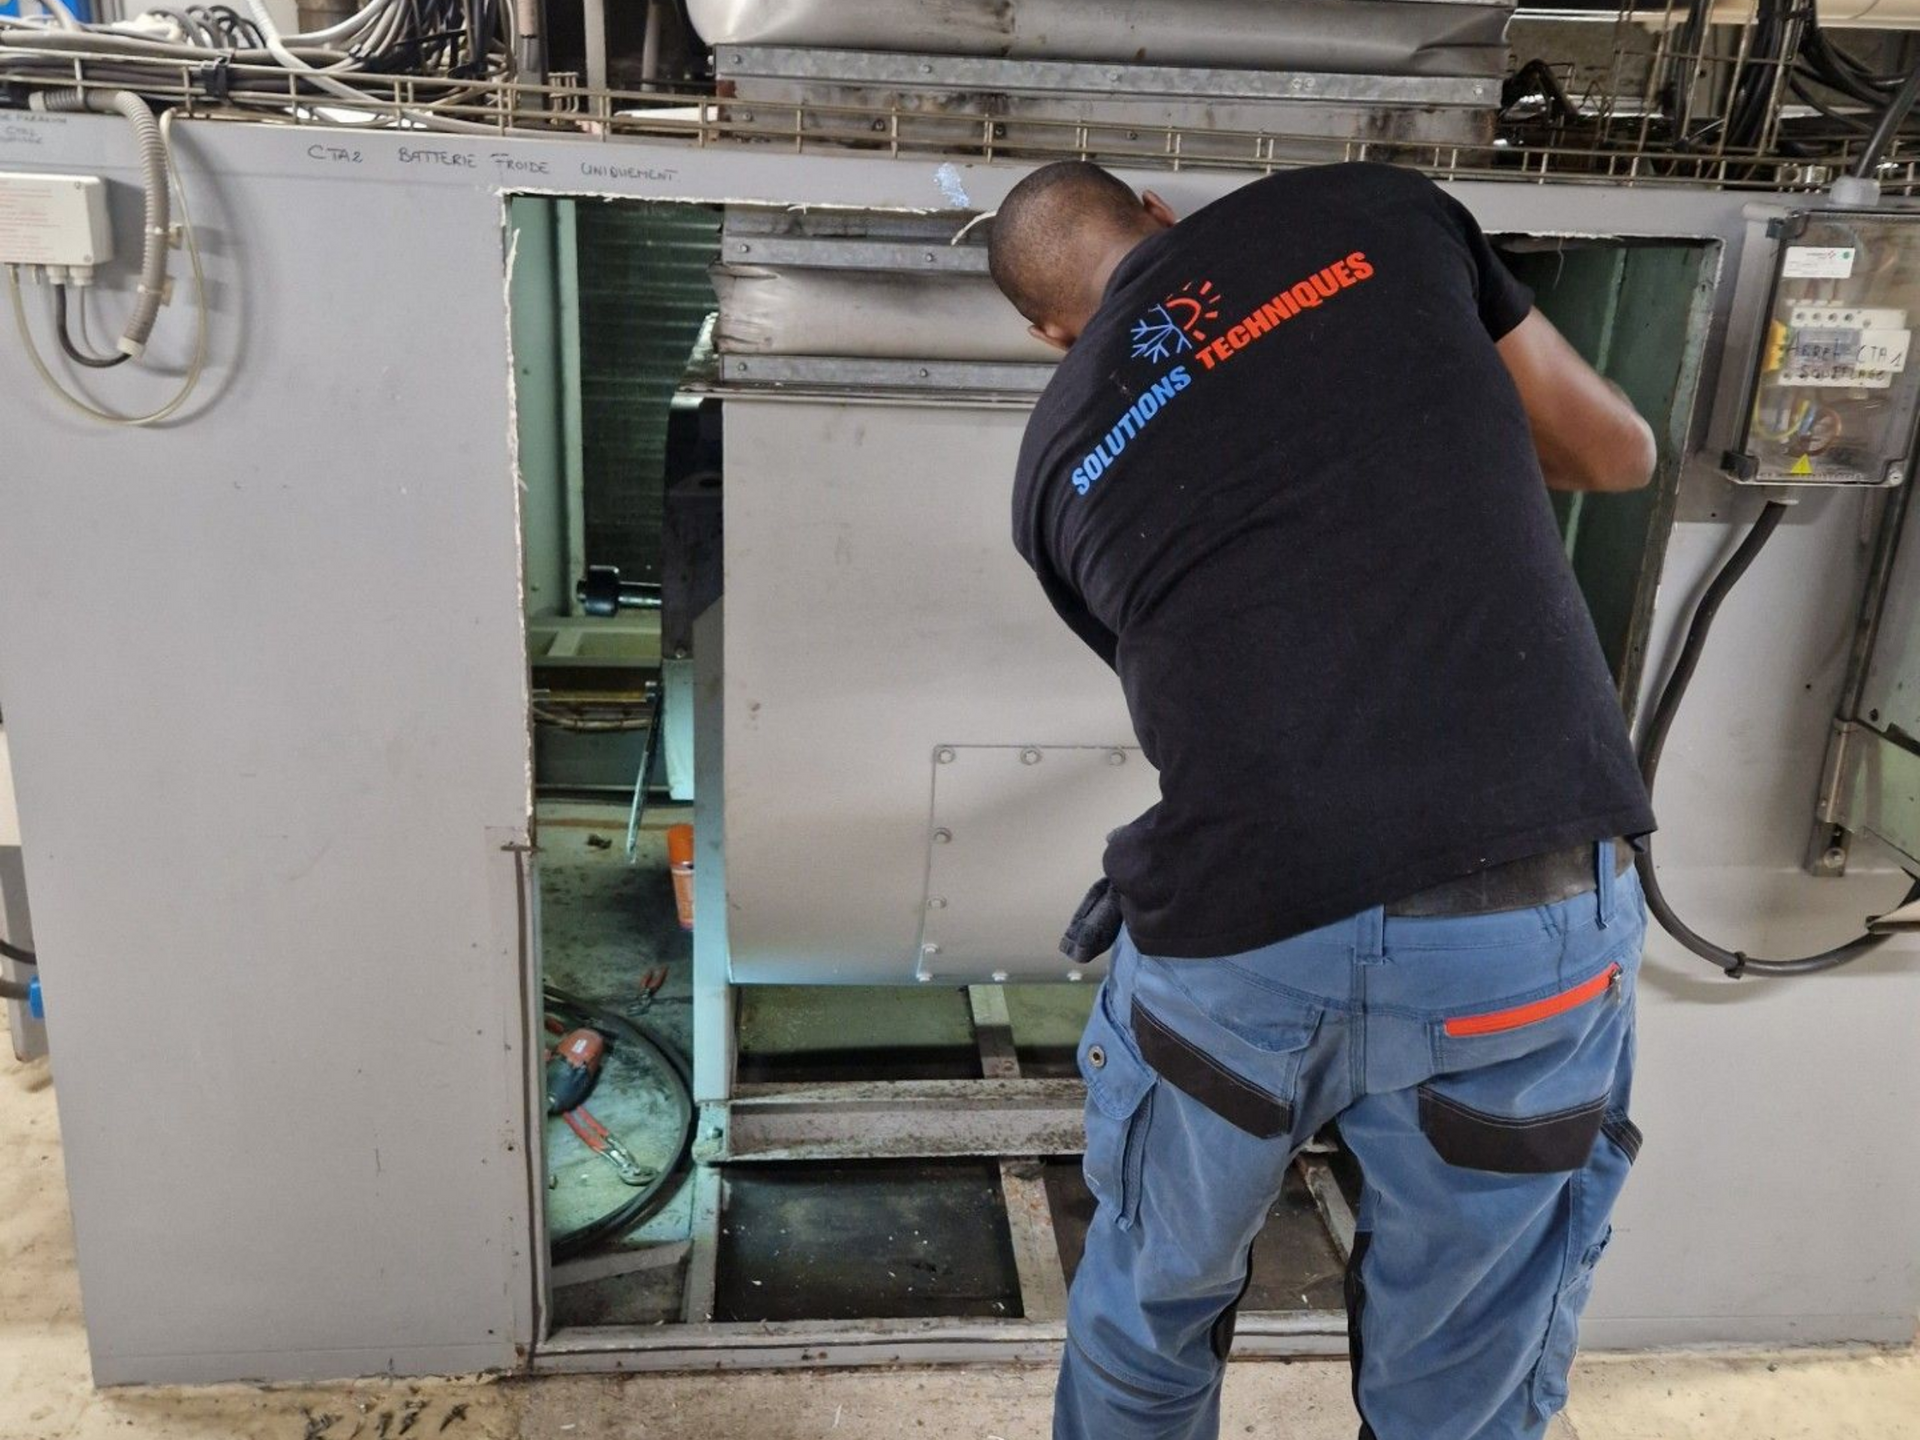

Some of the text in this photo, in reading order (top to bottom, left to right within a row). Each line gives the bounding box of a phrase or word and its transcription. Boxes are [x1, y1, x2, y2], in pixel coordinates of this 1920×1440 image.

[308, 145, 679, 181] CTA2 BATTERIE FROIDE UNIQUEMENT
[1072, 251, 1374, 495] SOLUTIONS TECHNIQUES
